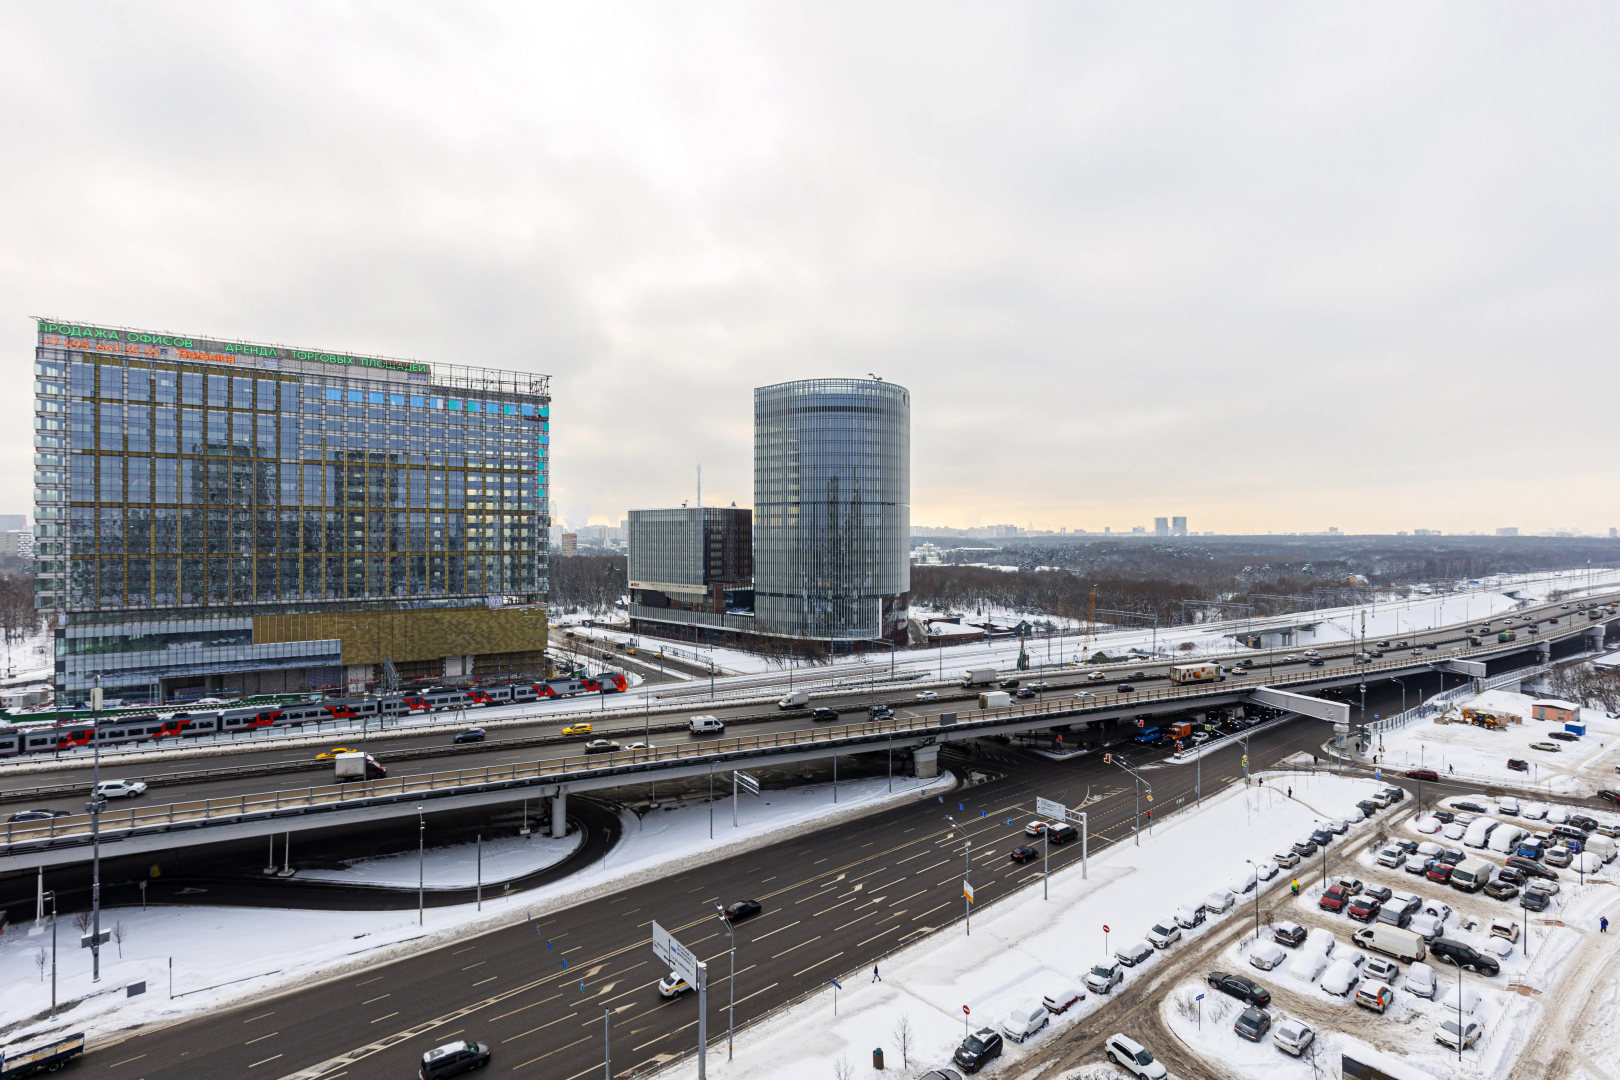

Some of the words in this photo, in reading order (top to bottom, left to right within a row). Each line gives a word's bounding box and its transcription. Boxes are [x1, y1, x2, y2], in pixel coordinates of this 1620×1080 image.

[37, 321, 119, 340] ПРОДАЖА
[127, 332, 194, 348] ОФИСОВ
[43, 337, 59, 347] +7
[63, 339, 90, 351] 495
[95, 343, 120, 354] 641
[123, 344, 140, 356] 35
[143, 347, 160, 358] 35
[178, 348, 236, 364] Botanica
[225, 343, 278, 358] АРЕНДА
[290, 350, 354, 365] ТОРГОВЫХ
